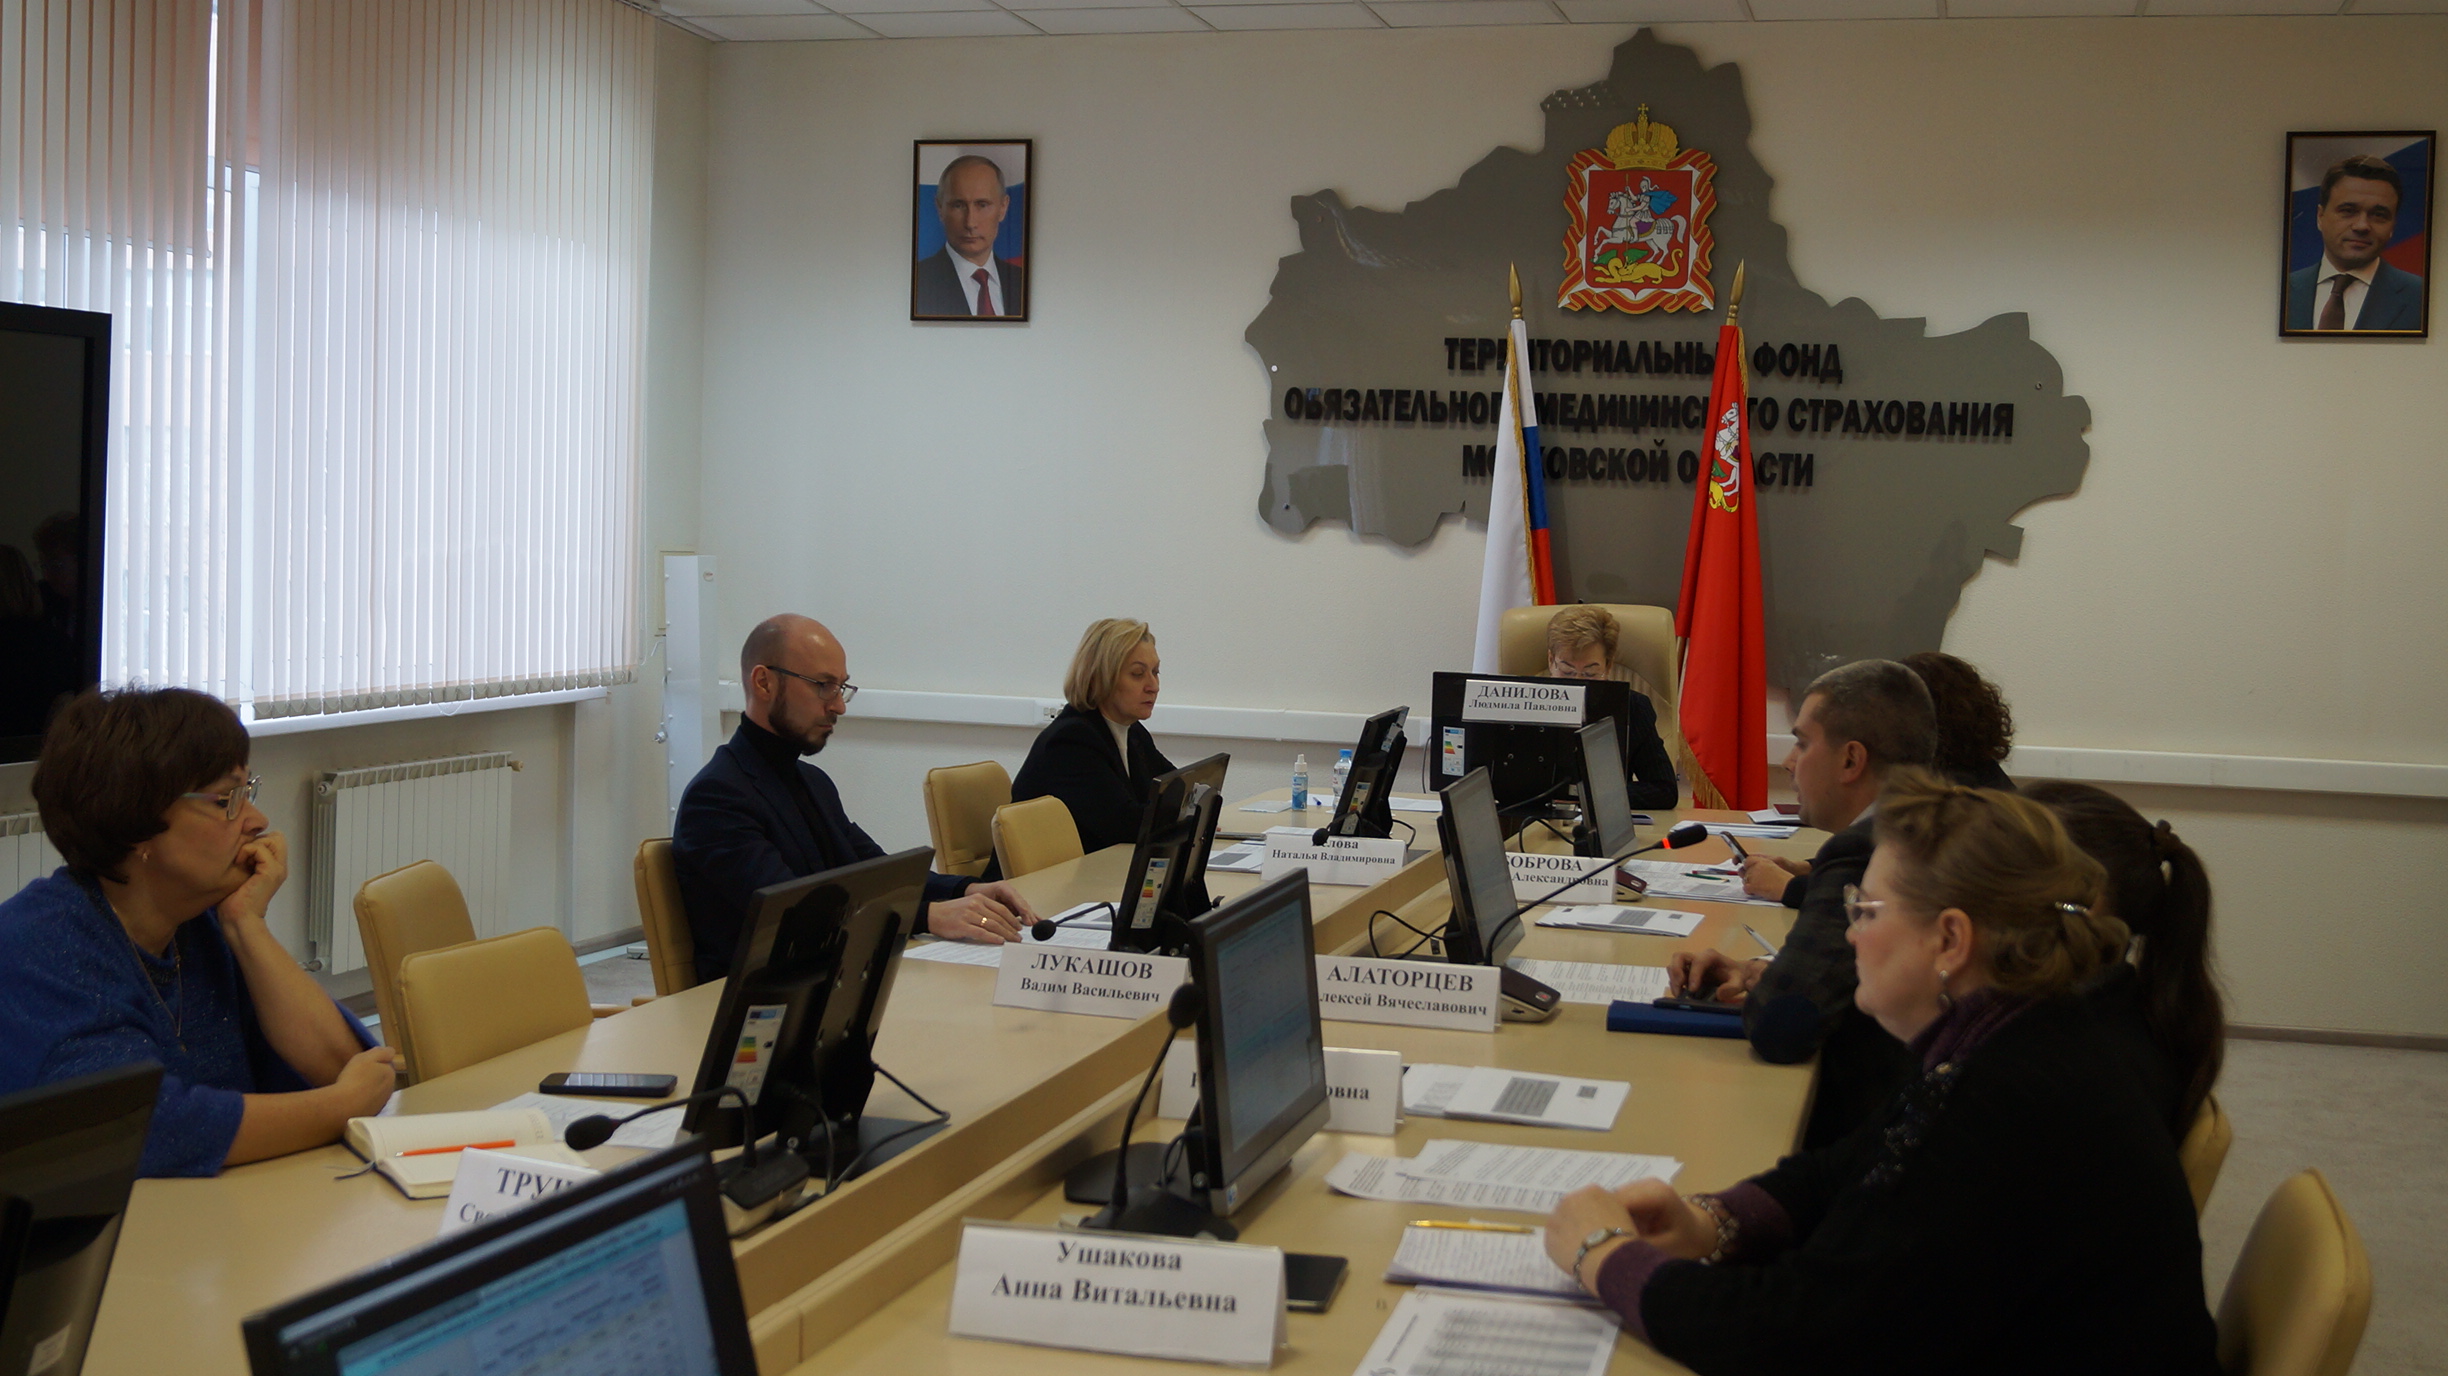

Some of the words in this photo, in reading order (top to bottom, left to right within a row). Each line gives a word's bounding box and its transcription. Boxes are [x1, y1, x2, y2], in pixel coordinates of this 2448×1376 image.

[1445, 337, 1720, 376] ТЕРТОРИАЛЬНЫ
[1753, 341, 1843, 384] ФОНД
[1284, 387, 1503, 425] ОБЯЗАТЕЛЬНОГ
[1535, 392, 1779, 434] МЕДИЦИНСГО
[1787, 398, 2014, 437] СТРАХОВАНИЯ
[1468, 699, 1520, 711] Людмила
[1523, 701, 1577, 713] Павловна
[1477, 685, 1570, 701] ДАНИЛОВА
[1272, 849, 1318, 860] Наталья
[1320, 851, 1396, 865] Владимировна
[1312, 838, 1359, 850] лова
[1506, 855, 1583, 872] ОБРОВА
[1031, 952, 1154, 980] ЛУКАШОВ
[1326, 965, 1474, 993] АЛАТОРЦЕВ
[1020, 978, 1068, 996] Вадим
[1071, 982, 1161, 1004] Васильевич
[1319, 991, 1371, 1007] лексей
[1376, 994, 1488, 1017] Вячеславович
[1056, 1240, 1182, 1271] Ушакова
[991, 1273, 1062, 1301] Анна
[1072, 1278, 1237, 1313] Витальевна
